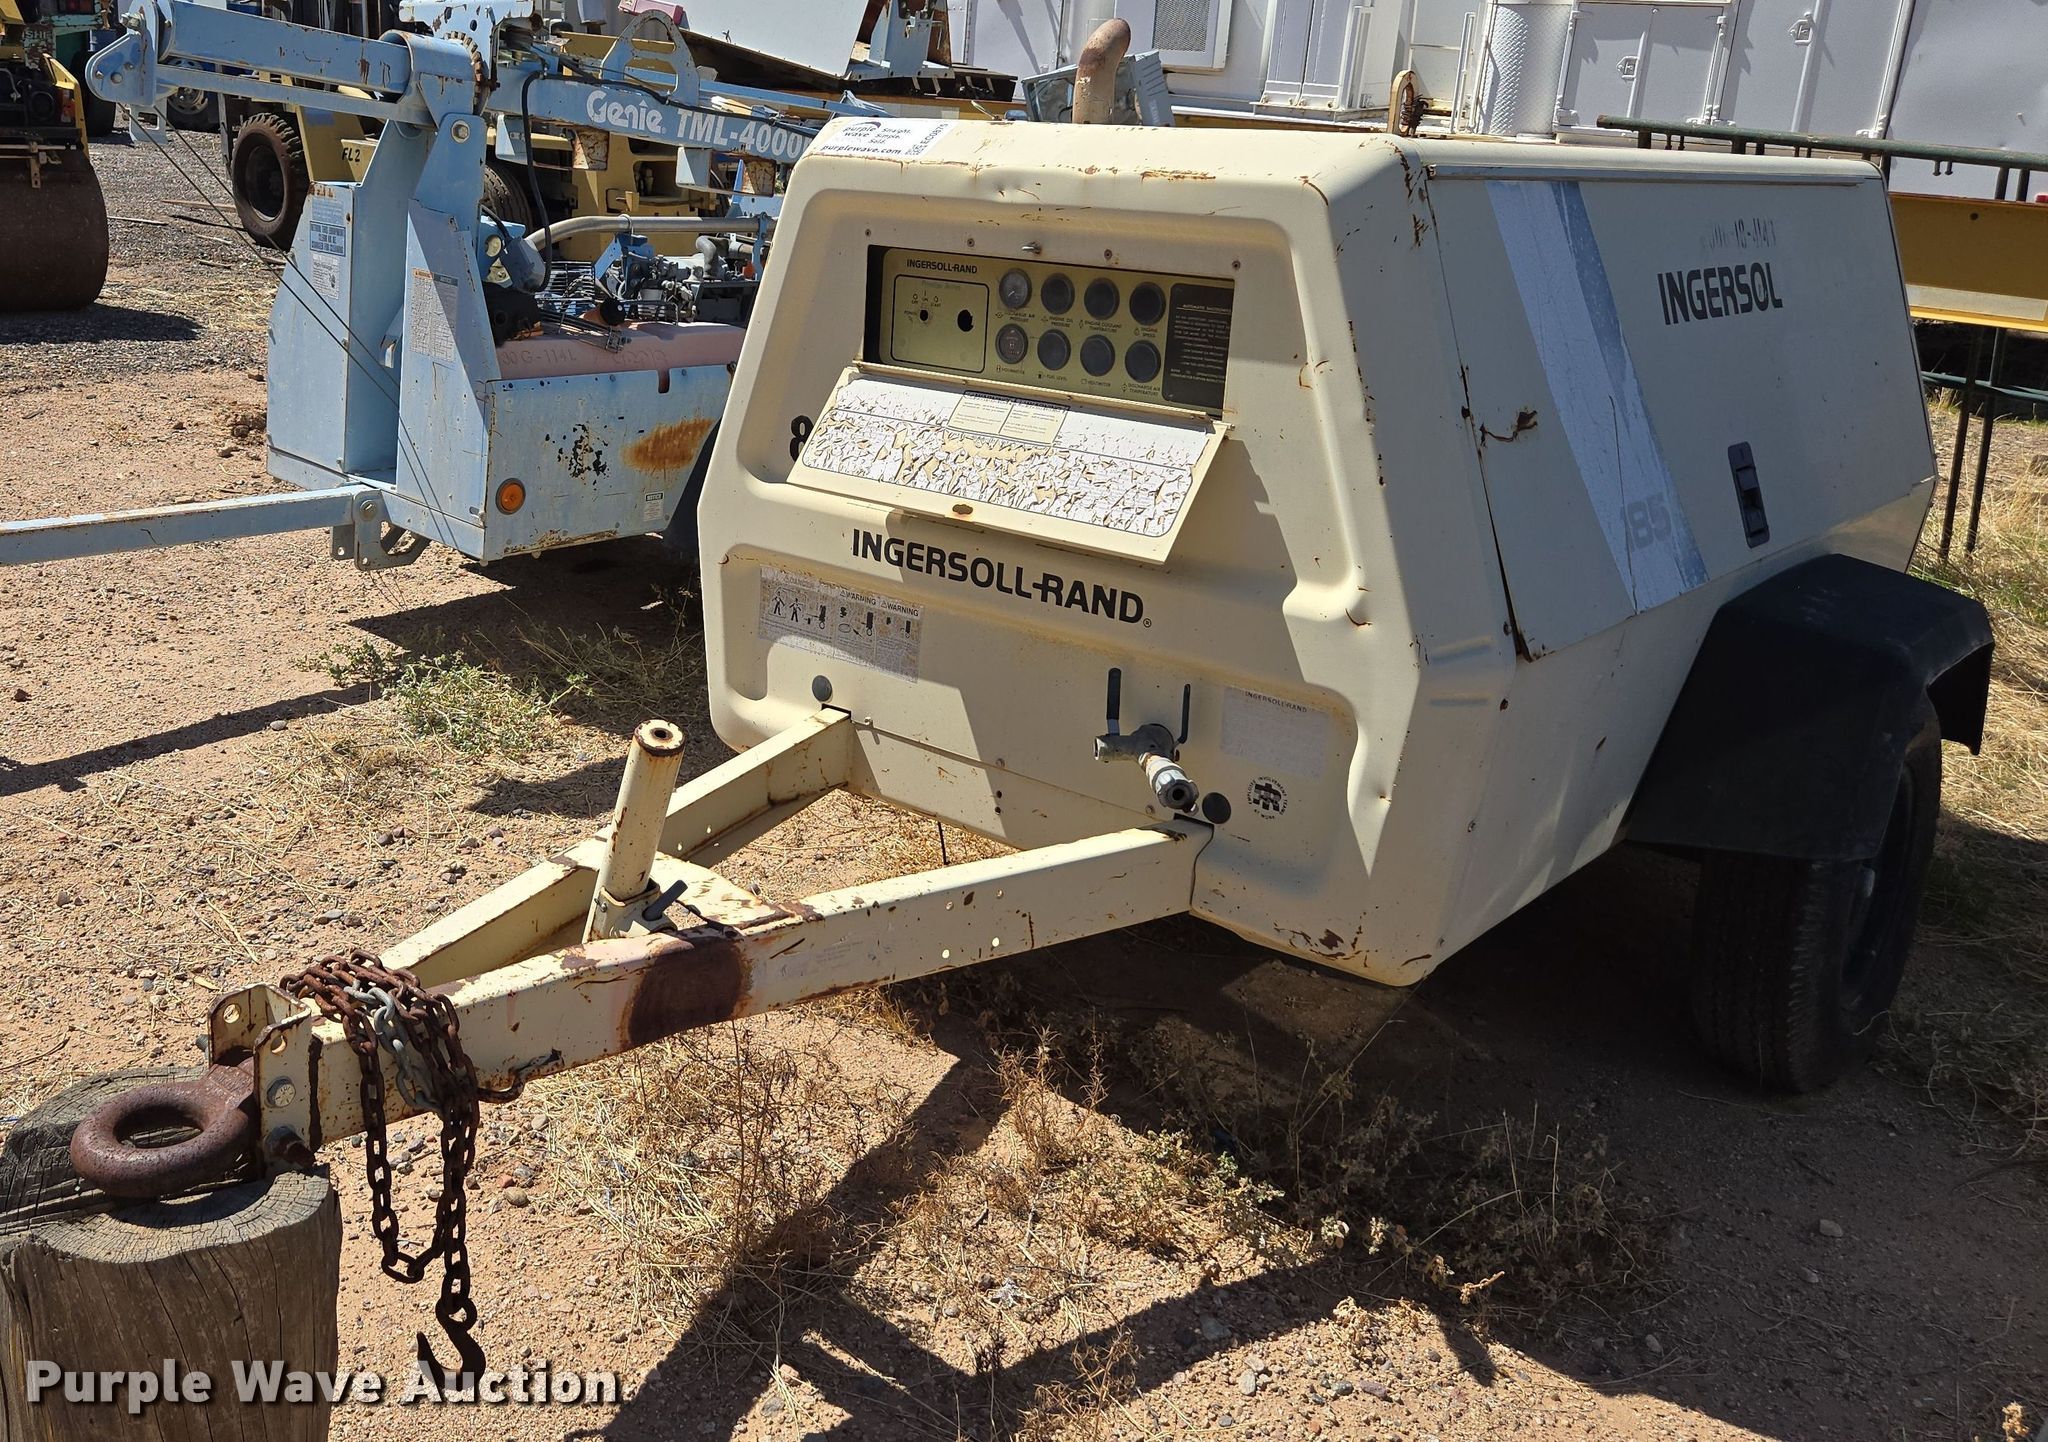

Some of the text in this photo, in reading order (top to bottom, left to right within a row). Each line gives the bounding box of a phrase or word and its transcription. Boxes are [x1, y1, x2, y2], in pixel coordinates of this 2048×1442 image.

[586, 90, 813, 159] Genie TML-4000
[842, 125, 876, 133] purple
[821, 145, 902, 155] purplewave.com
[906, 259, 978, 274] INGERSOLL-RAND
[1657, 262, 1783, 325] INGERSOL
[852, 528, 1145, 624] INGERSOLL-RAND
[846, 592, 877, 607] WARNING
[887, 604, 919, 618] WARNING
